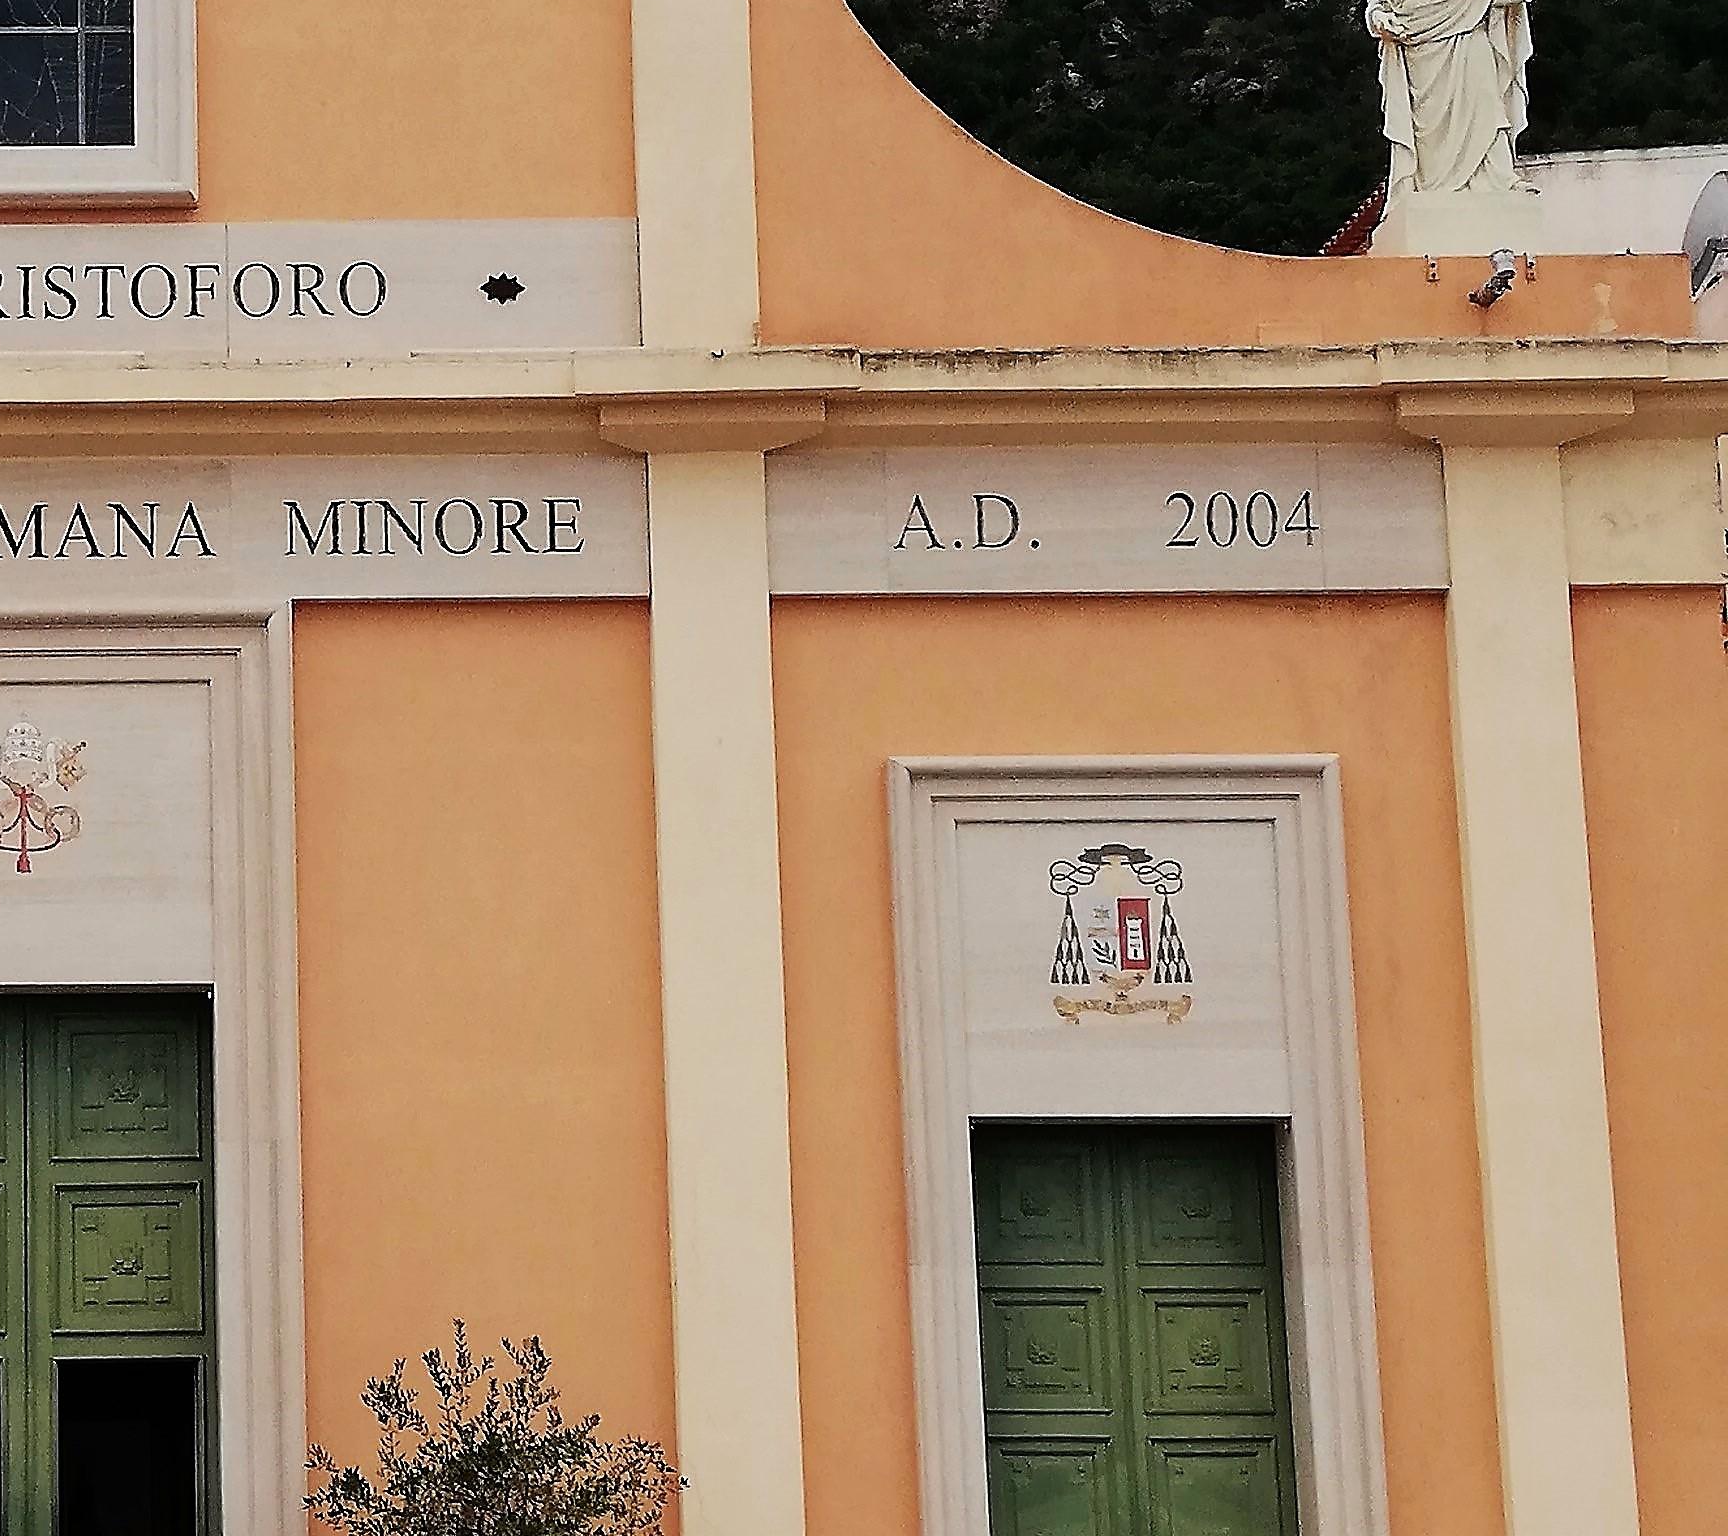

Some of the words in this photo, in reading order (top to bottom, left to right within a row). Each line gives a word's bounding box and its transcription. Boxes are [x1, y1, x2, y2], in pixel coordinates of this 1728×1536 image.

[283, 497, 586, 557] MINORE
[893, 494, 1041, 550] A.D.
[1165, 490, 1320, 548] 2004
